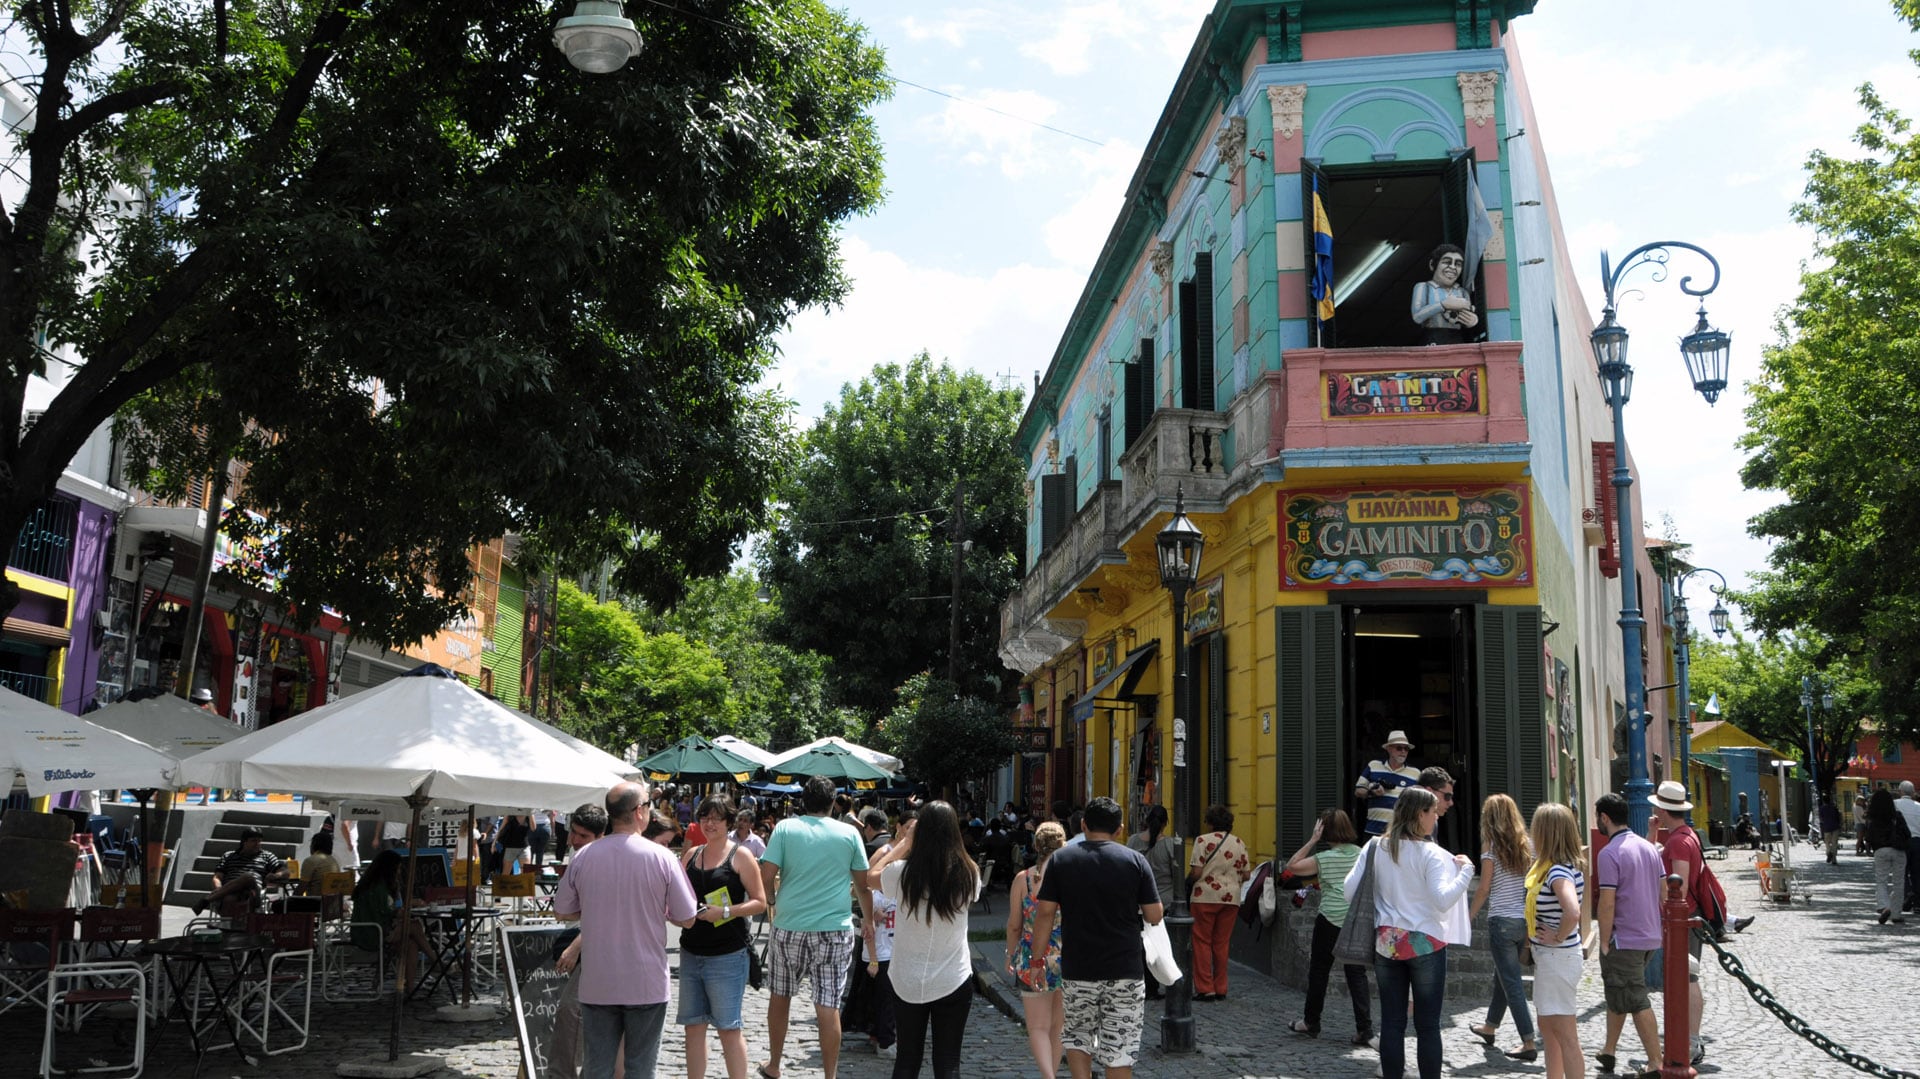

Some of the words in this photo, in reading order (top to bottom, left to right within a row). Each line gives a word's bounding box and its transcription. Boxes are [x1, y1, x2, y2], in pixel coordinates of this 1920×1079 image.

[1353, 377, 1457, 397] CAMINITO
[1373, 395, 1438, 407] AMIGO
[1358, 500, 1450, 518] HAVANNA
[1318, 520, 1492, 556] CAMINITO
[1381, 559, 1411, 574] DESDE
[1412, 560, 1432, 573] 1948
[523, 1001, 534, 1018] 2
